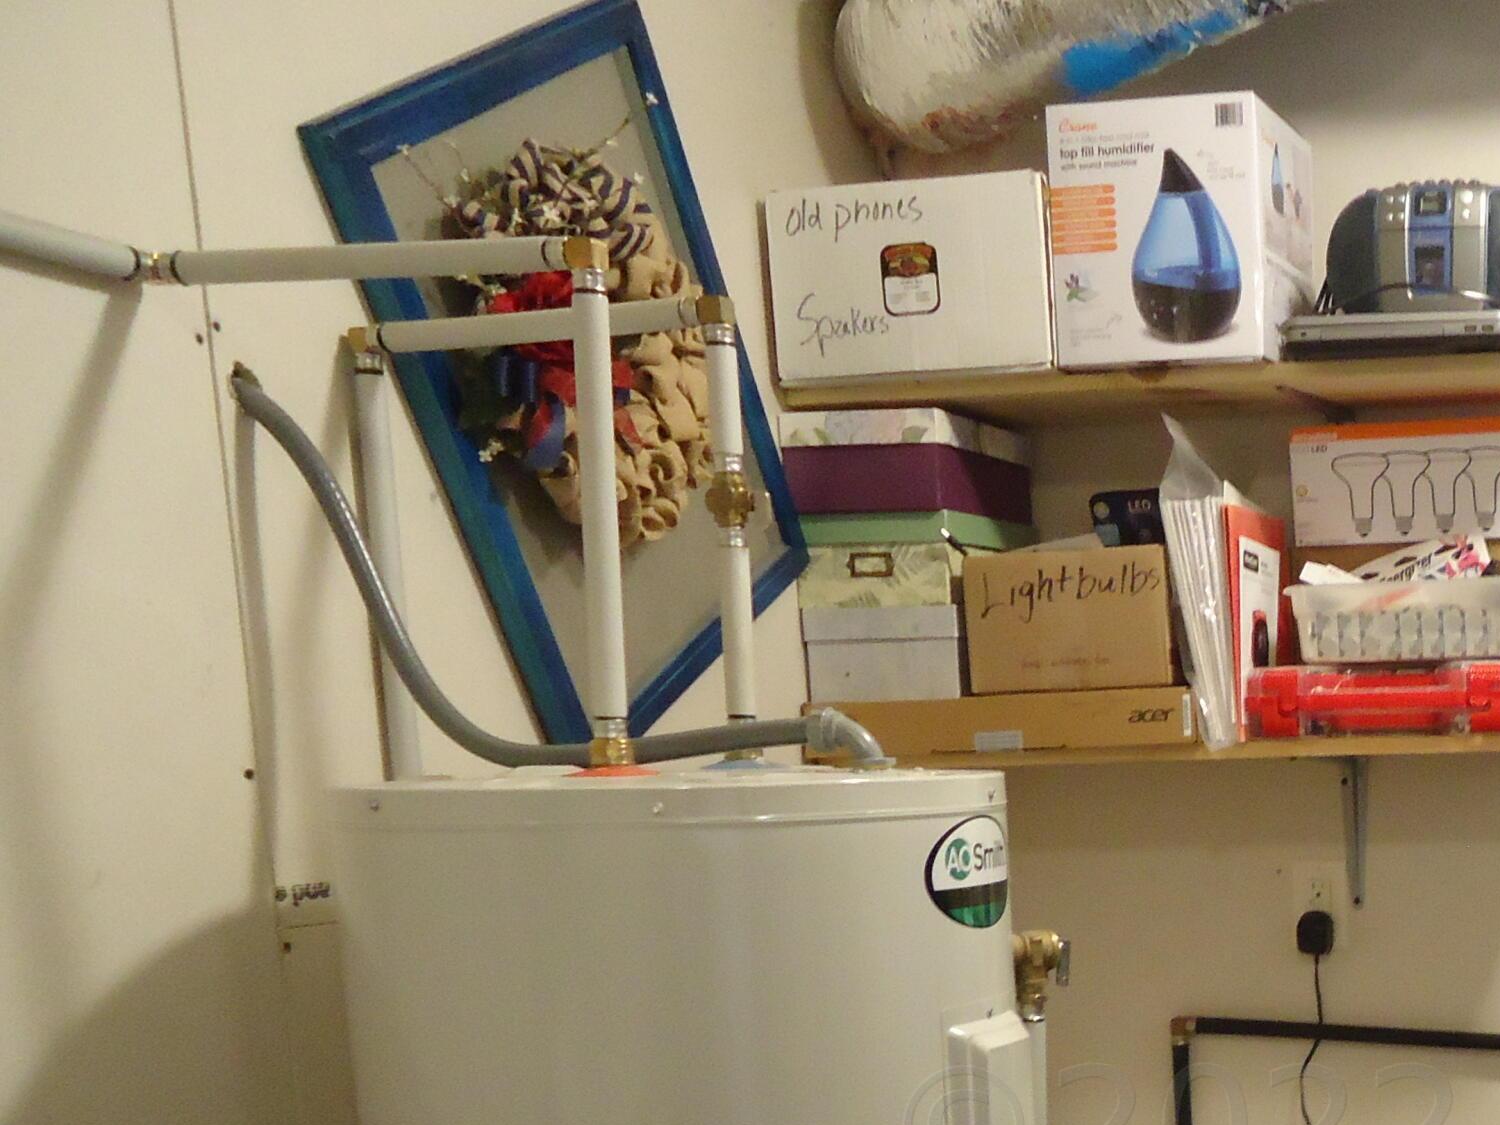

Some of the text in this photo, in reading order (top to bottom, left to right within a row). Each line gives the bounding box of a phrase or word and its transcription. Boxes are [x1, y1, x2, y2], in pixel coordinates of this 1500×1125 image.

[1060, 142, 1155, 160] top fill humidifier
[834, 195, 924, 242] phones
[1128, 707, 1175, 723] acer
